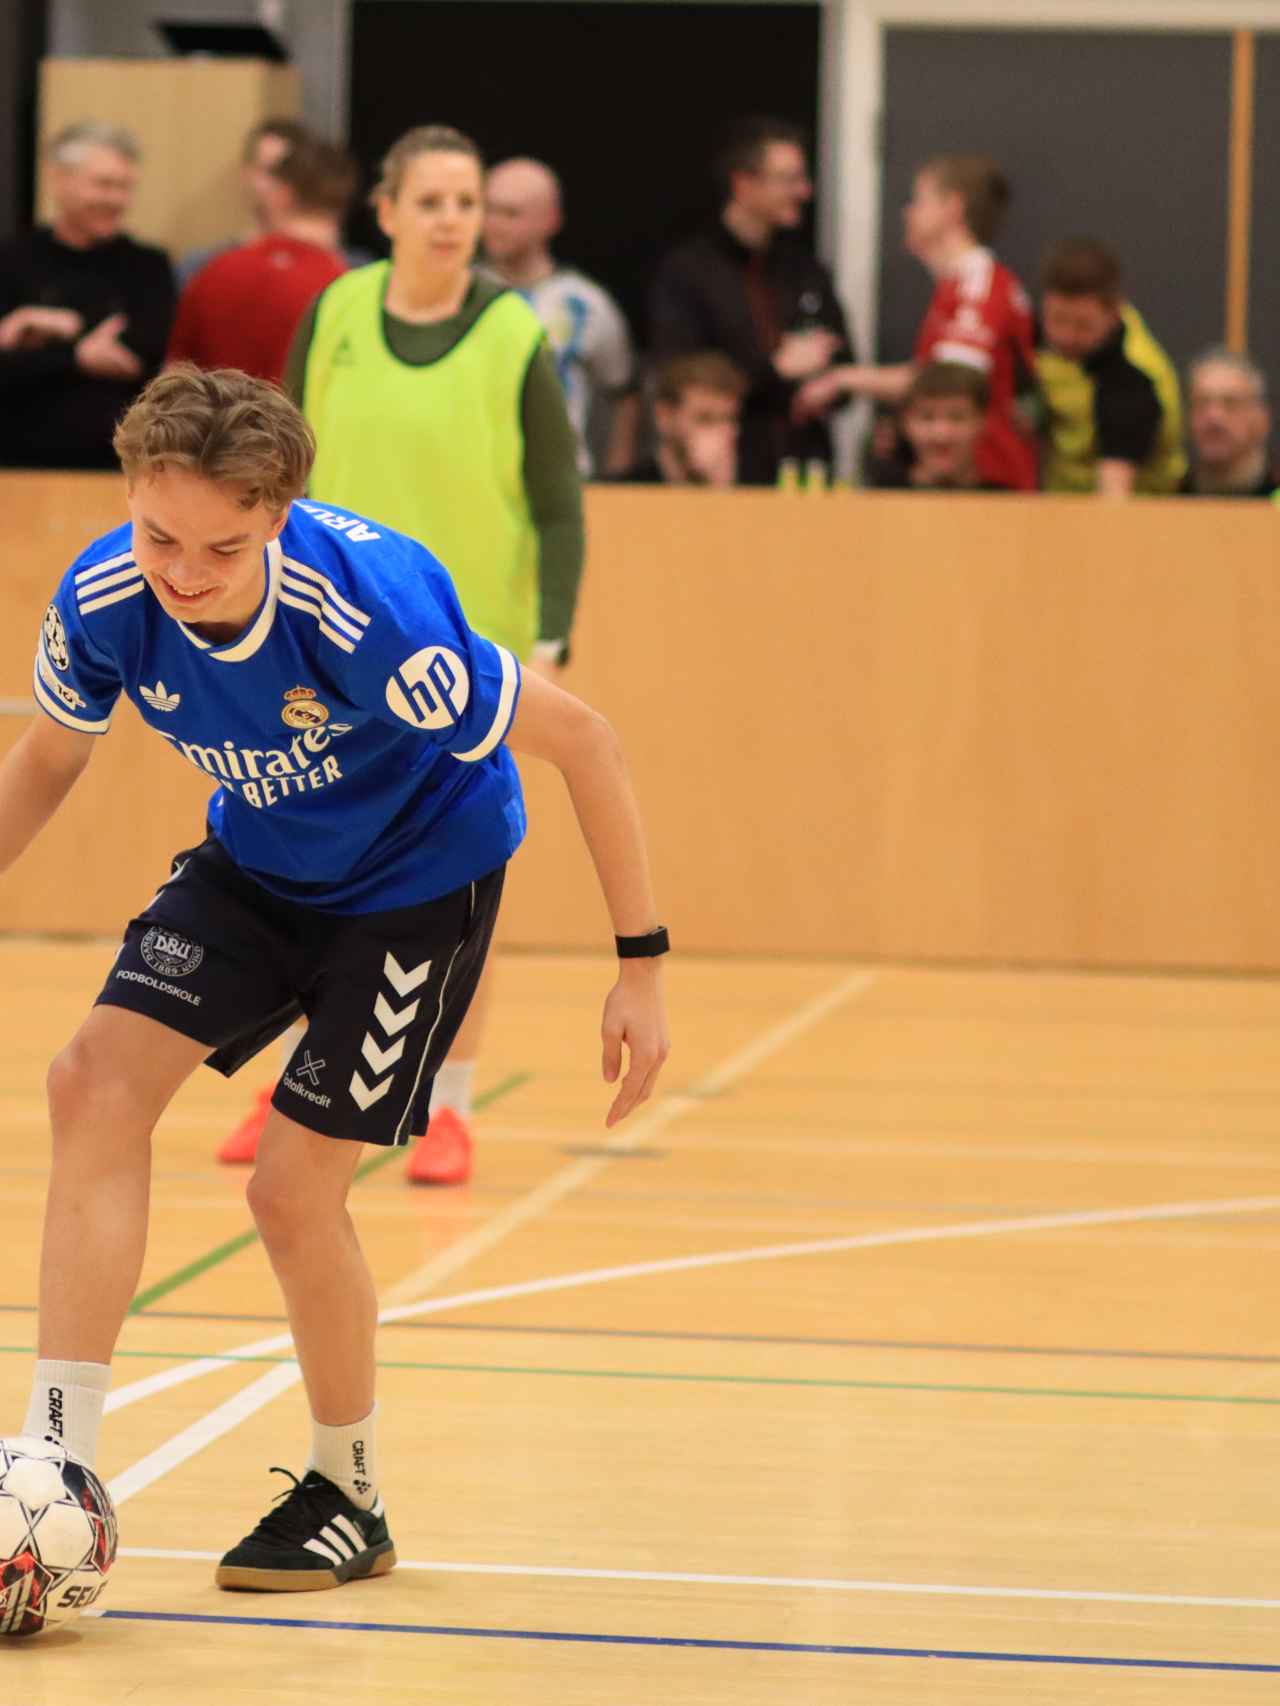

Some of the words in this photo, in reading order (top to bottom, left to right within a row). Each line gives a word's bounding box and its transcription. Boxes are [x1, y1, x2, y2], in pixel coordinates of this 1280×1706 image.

[391, 652, 463, 725] hp
[242, 755, 344, 808] BETTER
[153, 934, 192, 960] DBU
[115, 970, 202, 1007] FODBOLDSKOLE
[48, 1386, 63, 1438] CRAFT
[352, 1440, 367, 1476] CRAFT
